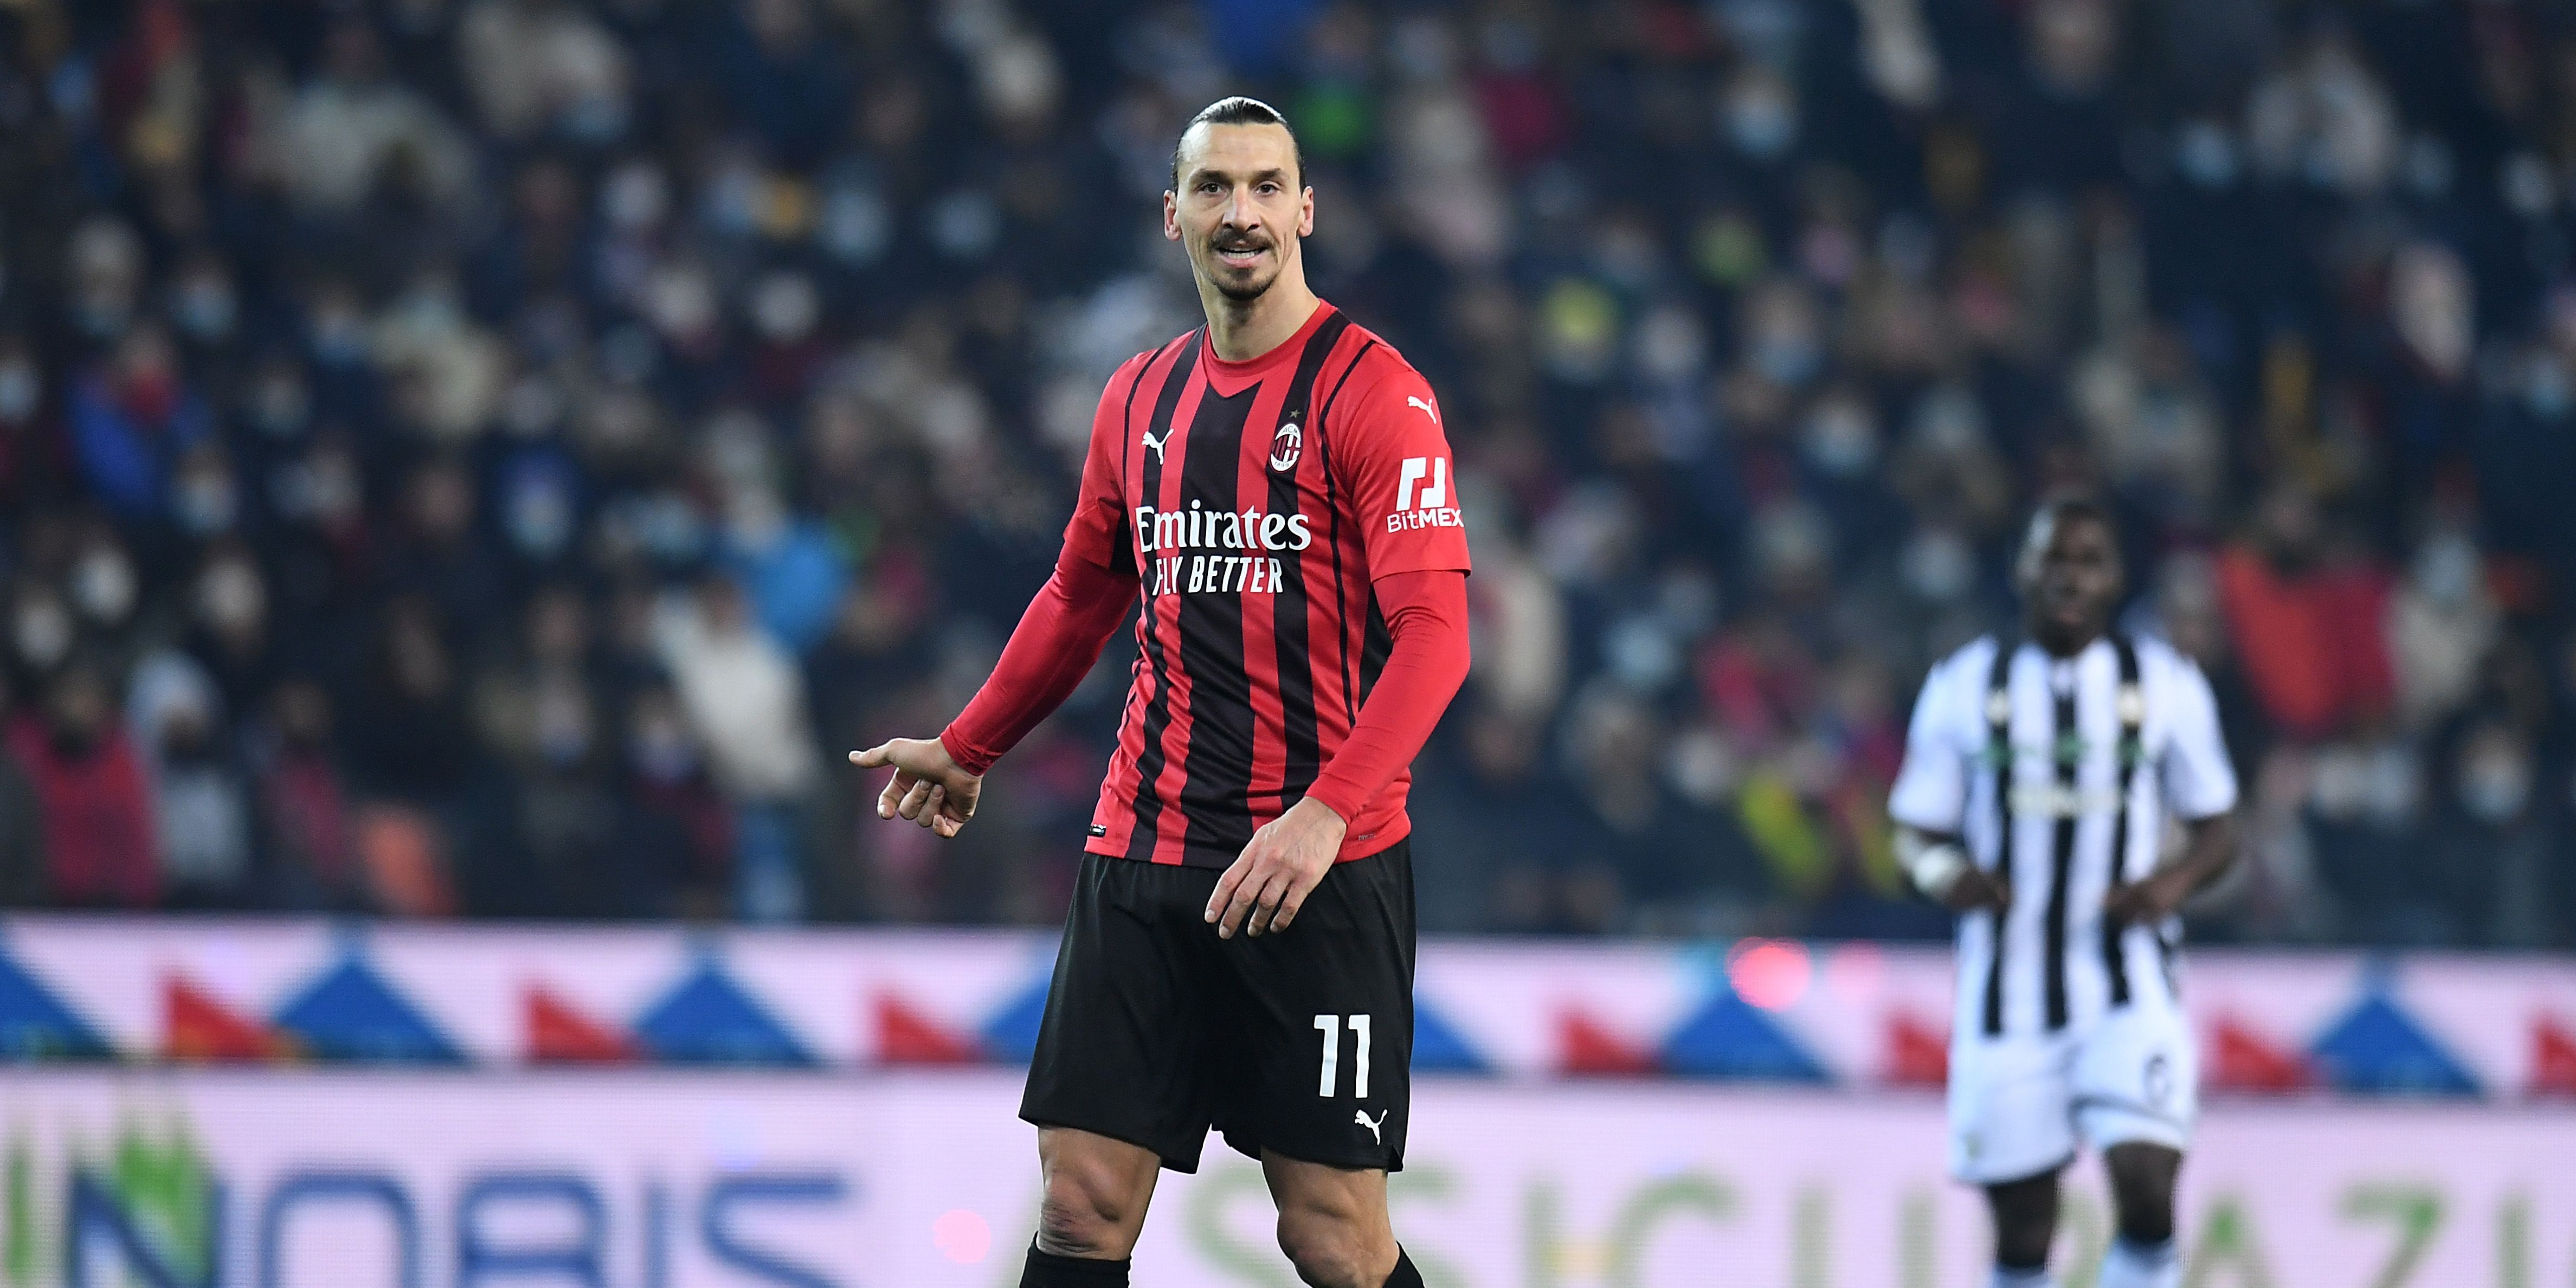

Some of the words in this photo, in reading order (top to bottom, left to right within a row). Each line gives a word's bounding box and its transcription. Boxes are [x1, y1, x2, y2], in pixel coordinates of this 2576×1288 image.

[1281, 426, 1298, 436] ACM
[1135, 499, 1311, 553] Emirates
[1387, 507, 1464, 533] BitMEX
[1152, 556, 1183, 596] FLY
[1188, 555, 1284, 593] BETTER
[1313, 1014, 1370, 1098] 11
